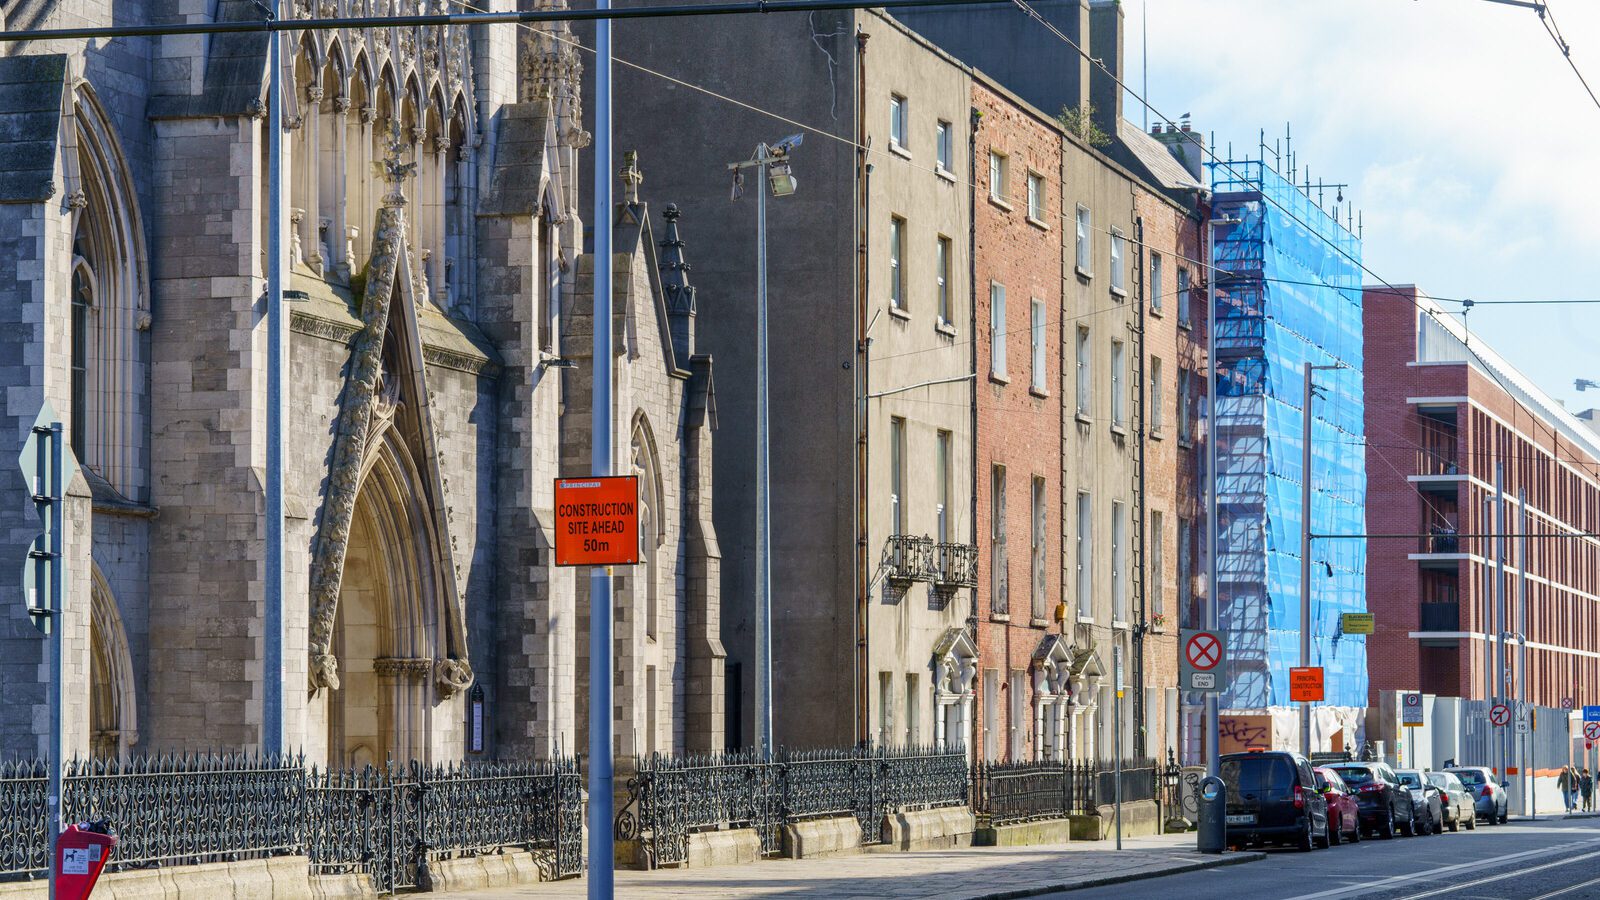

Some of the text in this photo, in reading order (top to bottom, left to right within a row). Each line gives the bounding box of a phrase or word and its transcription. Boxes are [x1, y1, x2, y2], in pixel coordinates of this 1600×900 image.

[559, 502, 634, 517] CONSTRUCTION
[568, 520, 624, 534] SITE AHEAD
[583, 539, 609, 552] 50m
